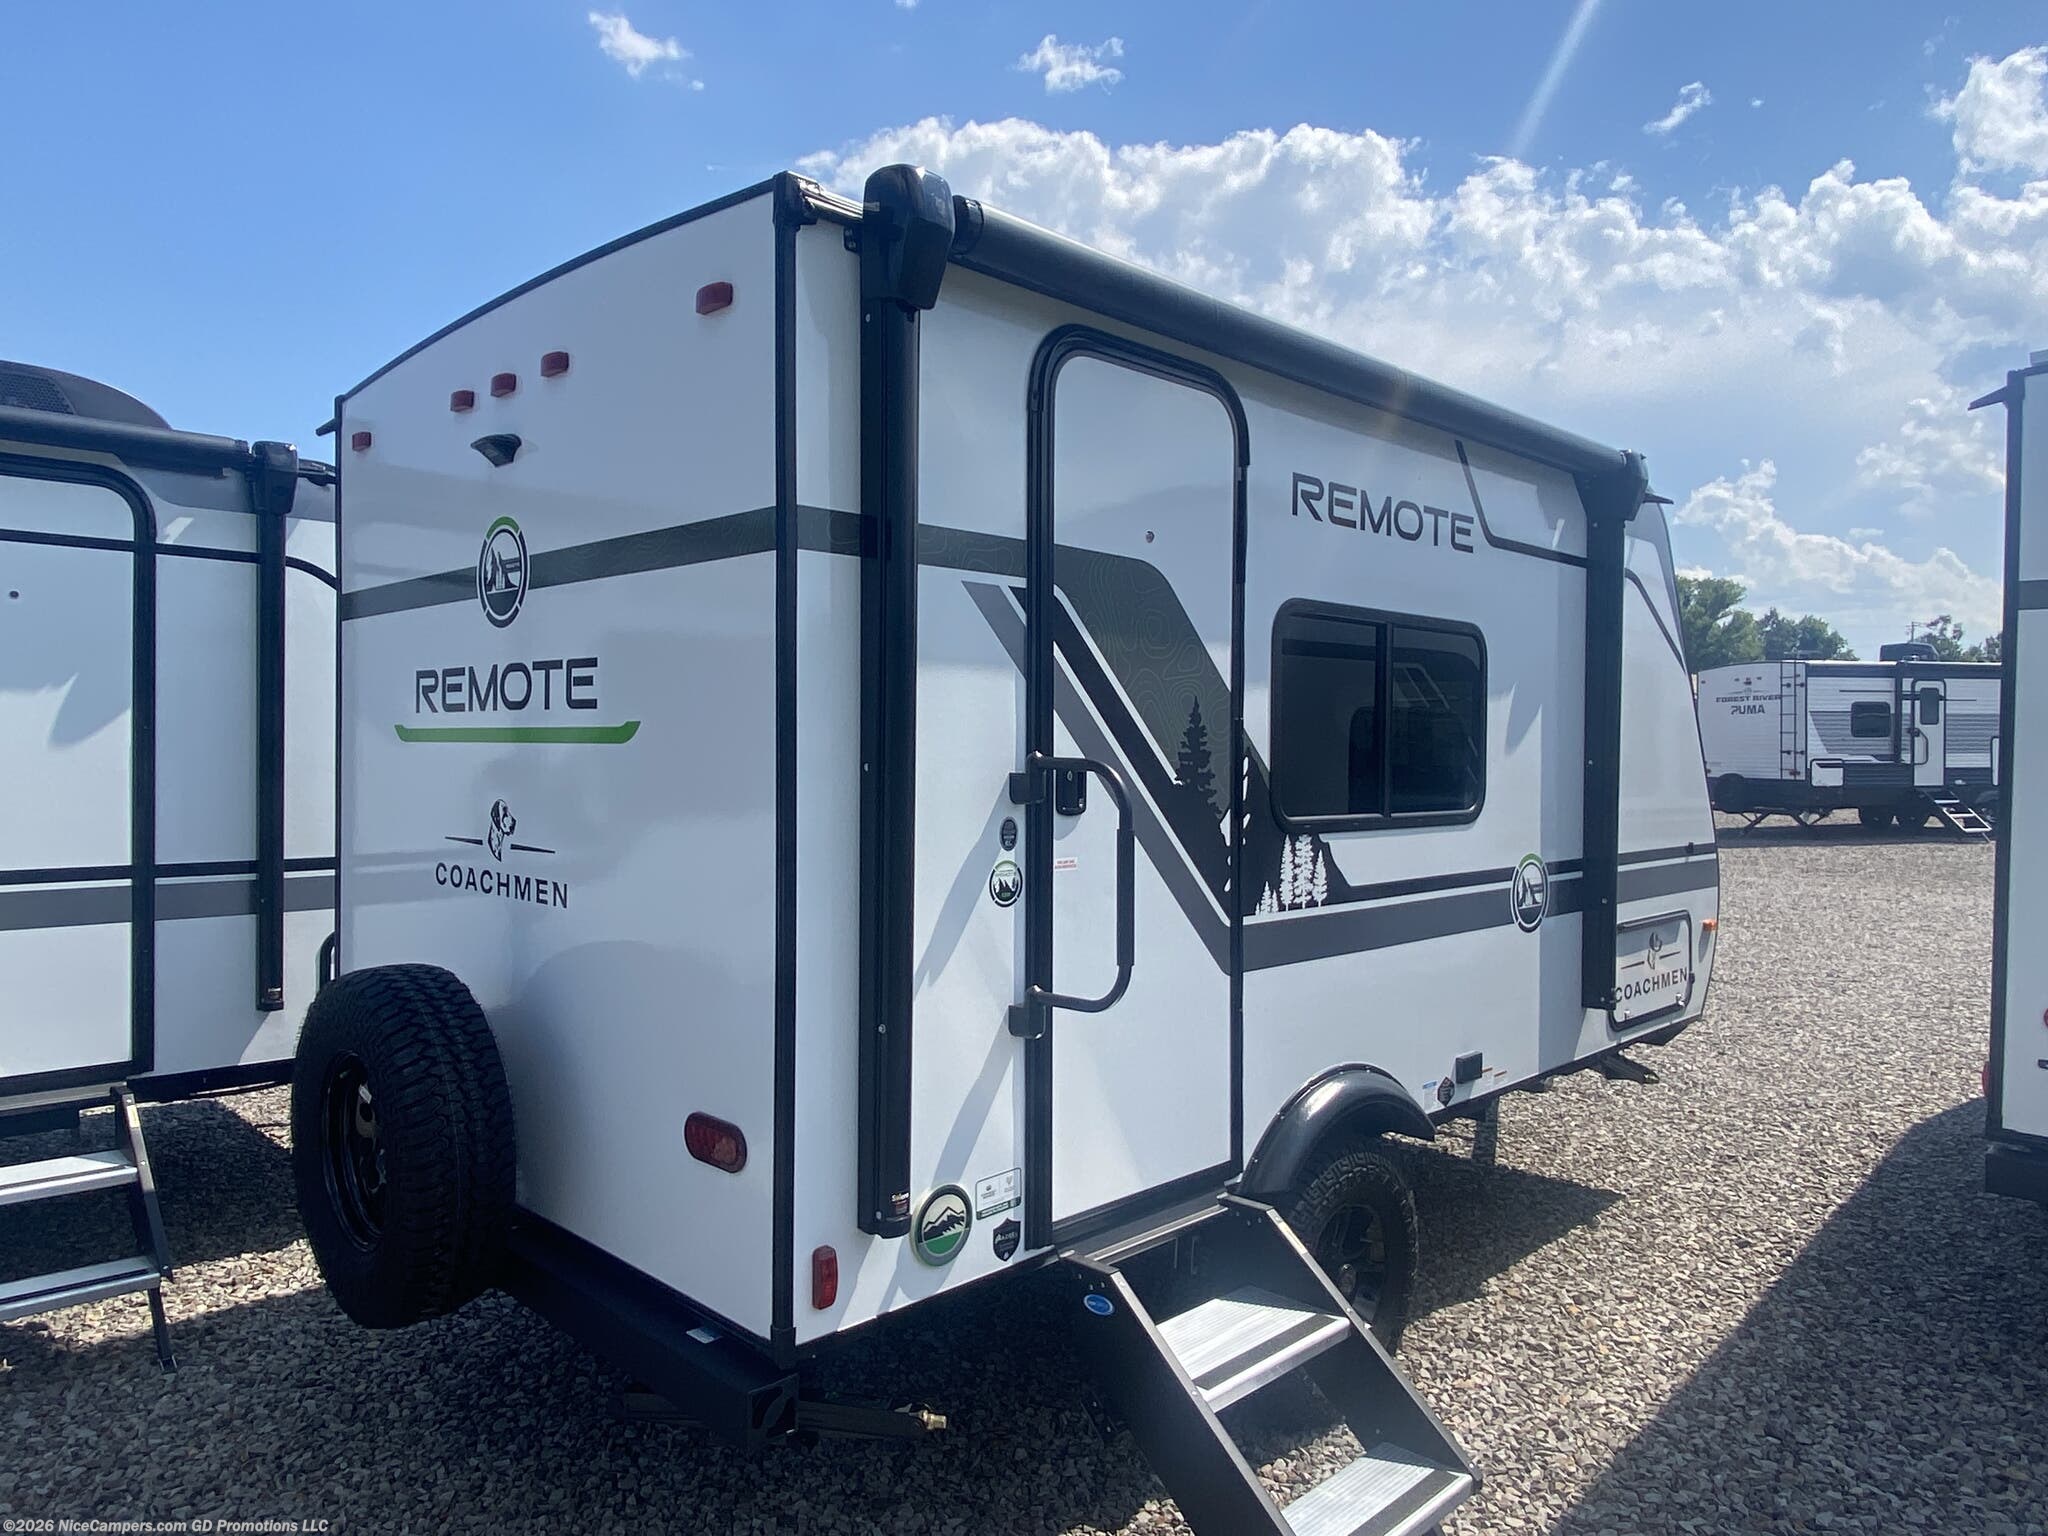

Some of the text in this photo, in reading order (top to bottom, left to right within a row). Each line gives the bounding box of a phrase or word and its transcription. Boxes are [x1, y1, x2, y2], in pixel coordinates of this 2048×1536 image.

[1291, 471, 1474, 554] REMOTE
[415, 656, 598, 714] REMOTE
[1731, 704, 1765, 715] PUMA
[435, 862, 568, 909] COACHMEN
[1615, 968, 1687, 1003] COACHMEN
